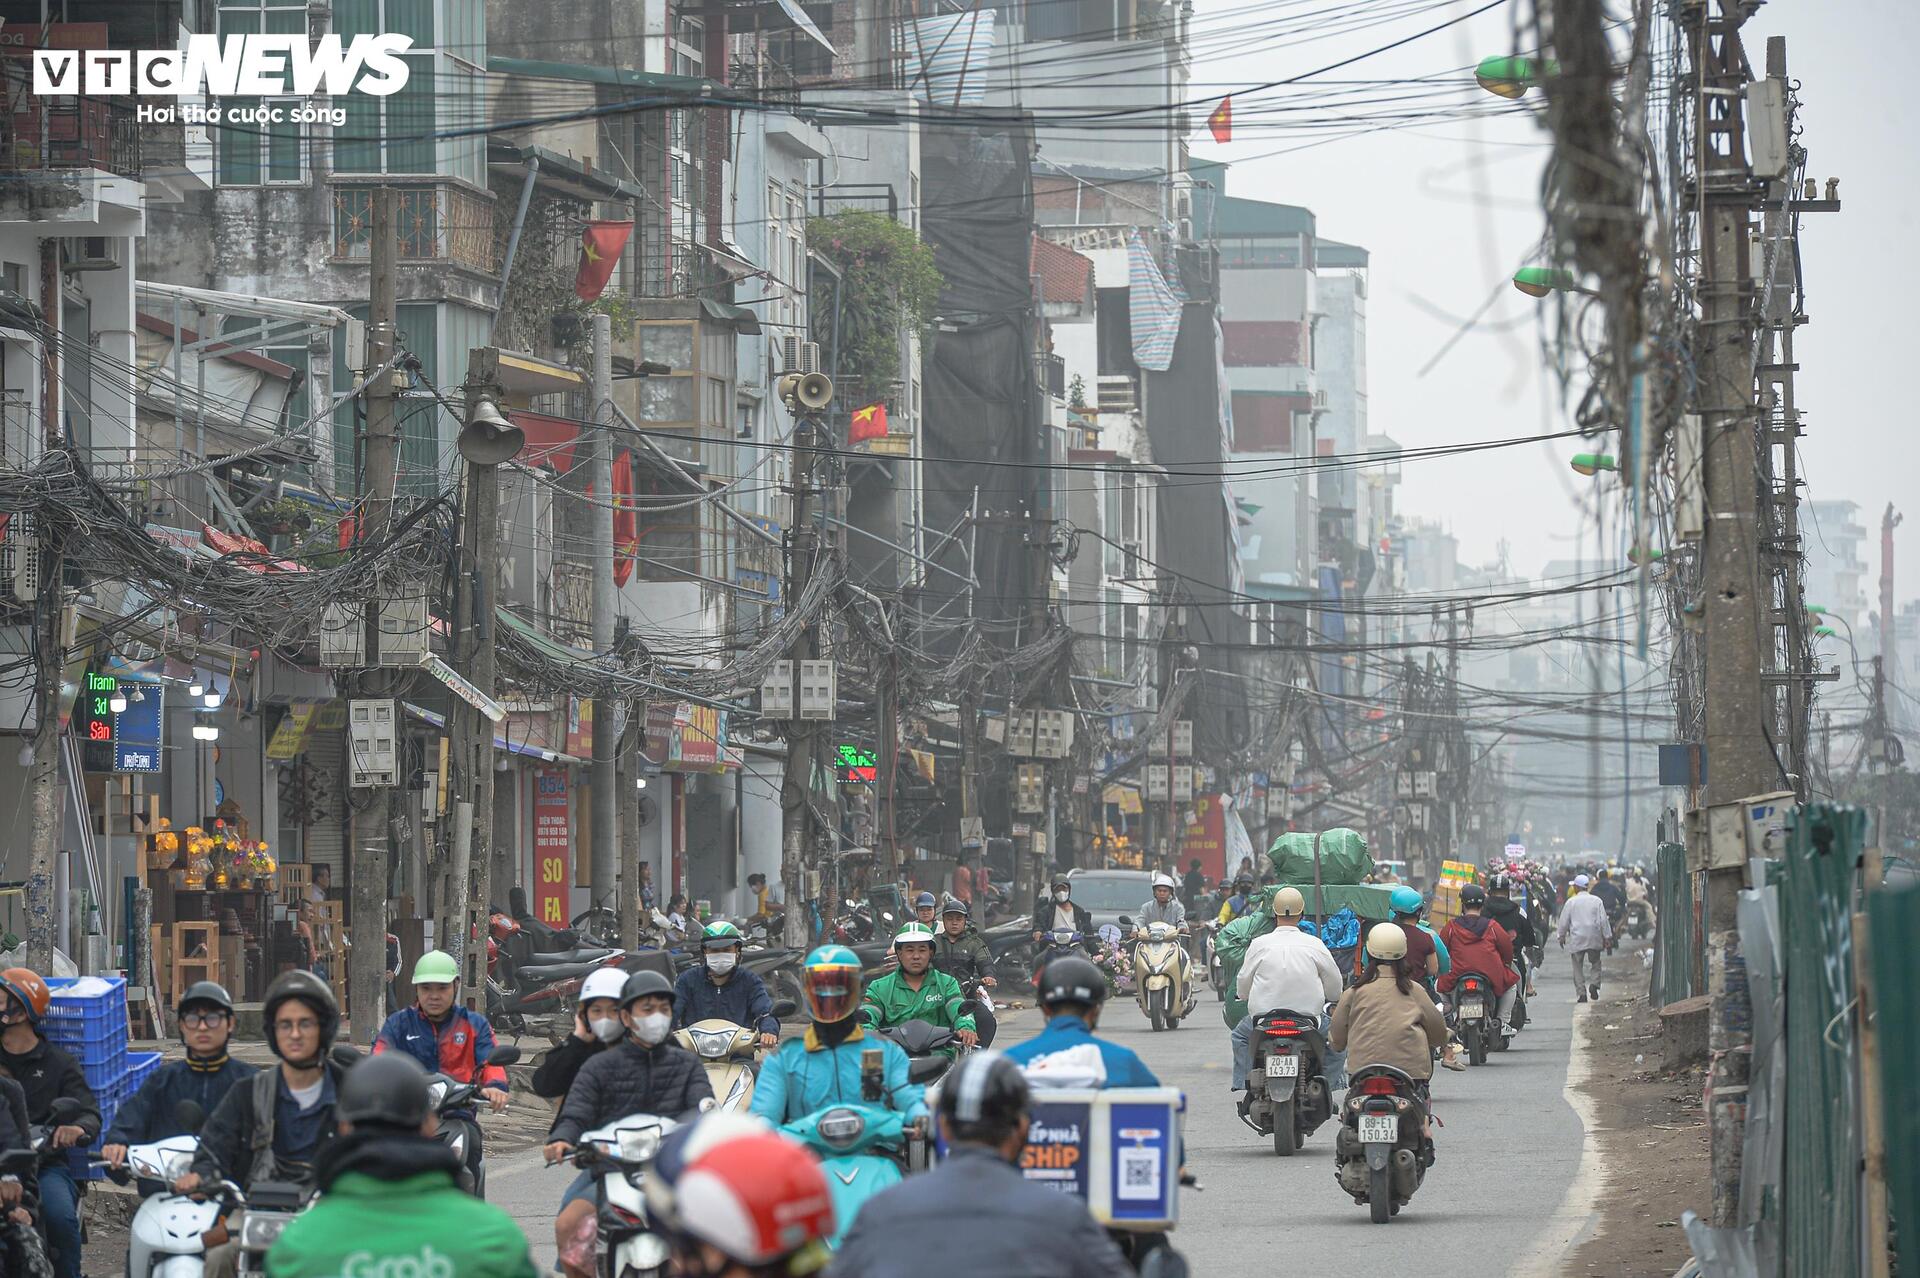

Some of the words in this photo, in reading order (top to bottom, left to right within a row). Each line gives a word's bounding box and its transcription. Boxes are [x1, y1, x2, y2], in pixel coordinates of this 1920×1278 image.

[94, 697, 107, 715] 3d
[90, 721, 110, 740] Sàn
[538, 775, 566, 794] 854
[543, 857, 562, 883] SO
[544, 896, 561, 922] FA
[925, 993, 943, 1002] Grab
[1269, 1066, 1296, 1076] 143.73
[1364, 1117, 1392, 1129] 89-E1
[1361, 1129, 1395, 1141] 150.34
